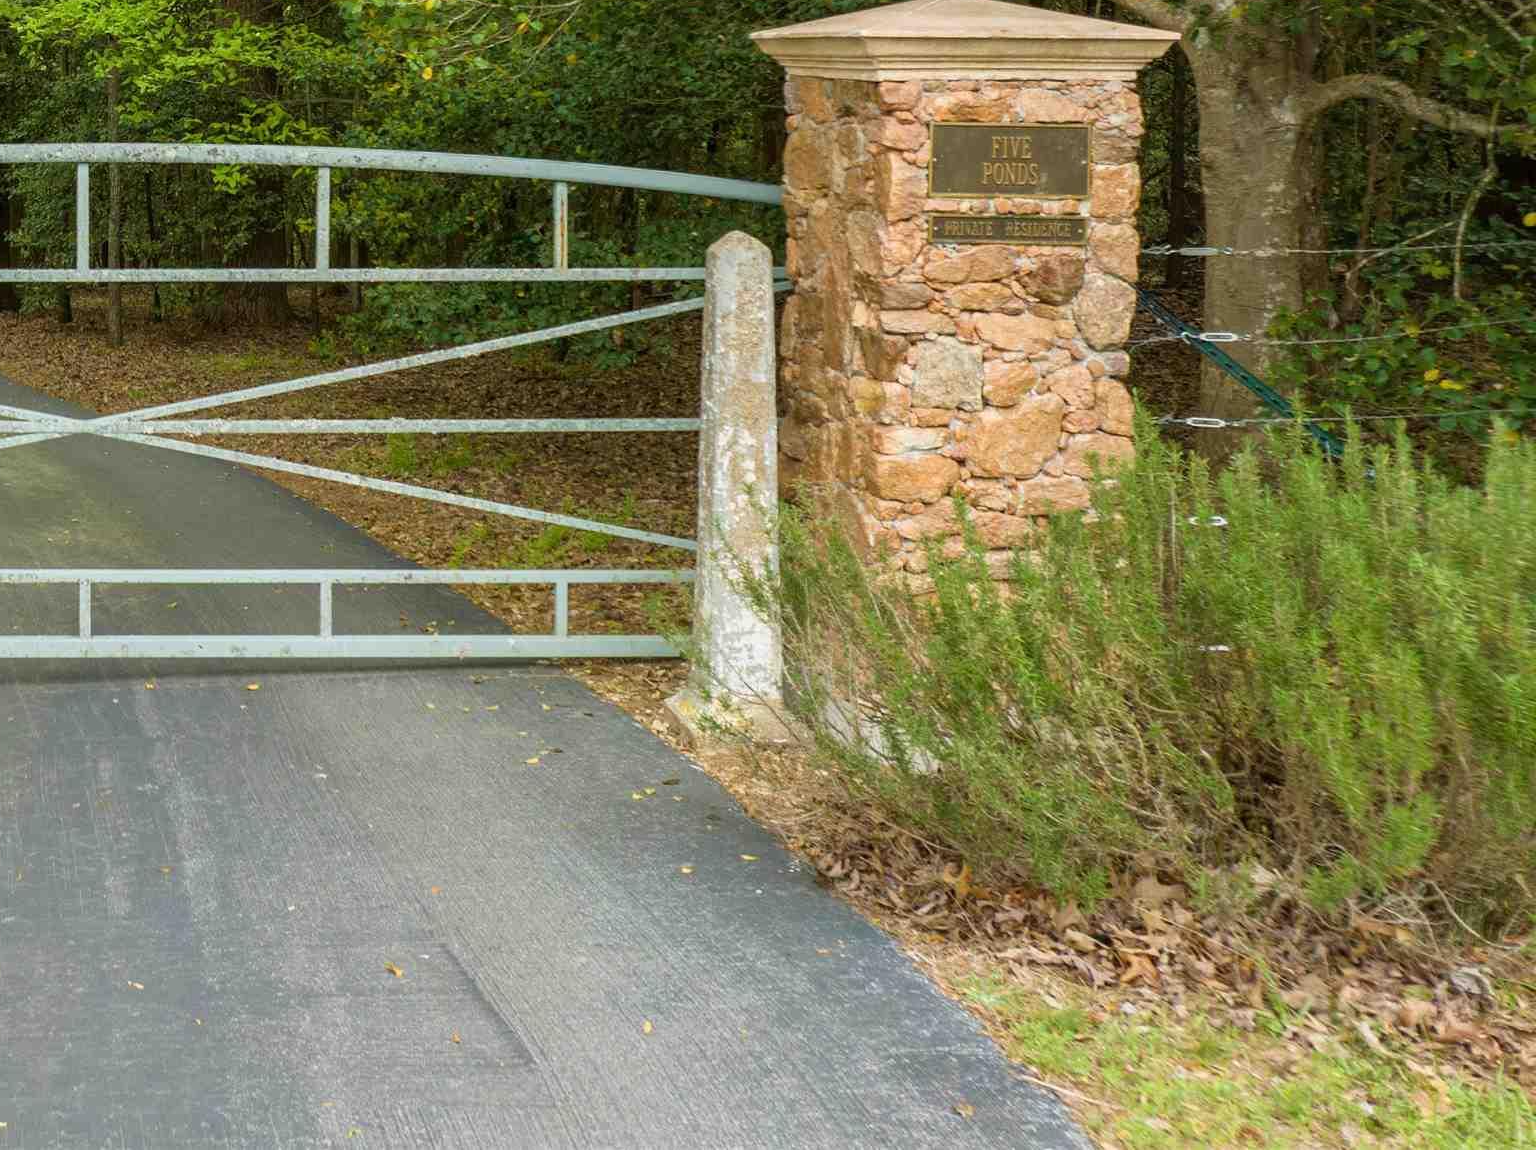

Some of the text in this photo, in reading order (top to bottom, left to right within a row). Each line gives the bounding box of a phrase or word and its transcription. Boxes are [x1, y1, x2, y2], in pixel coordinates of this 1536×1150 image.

[991, 135, 1032, 159] FIVE
[982, 161, 1040, 185] PONDS
[943, 221, 1072, 237] PRIVATE RESIDENCE
